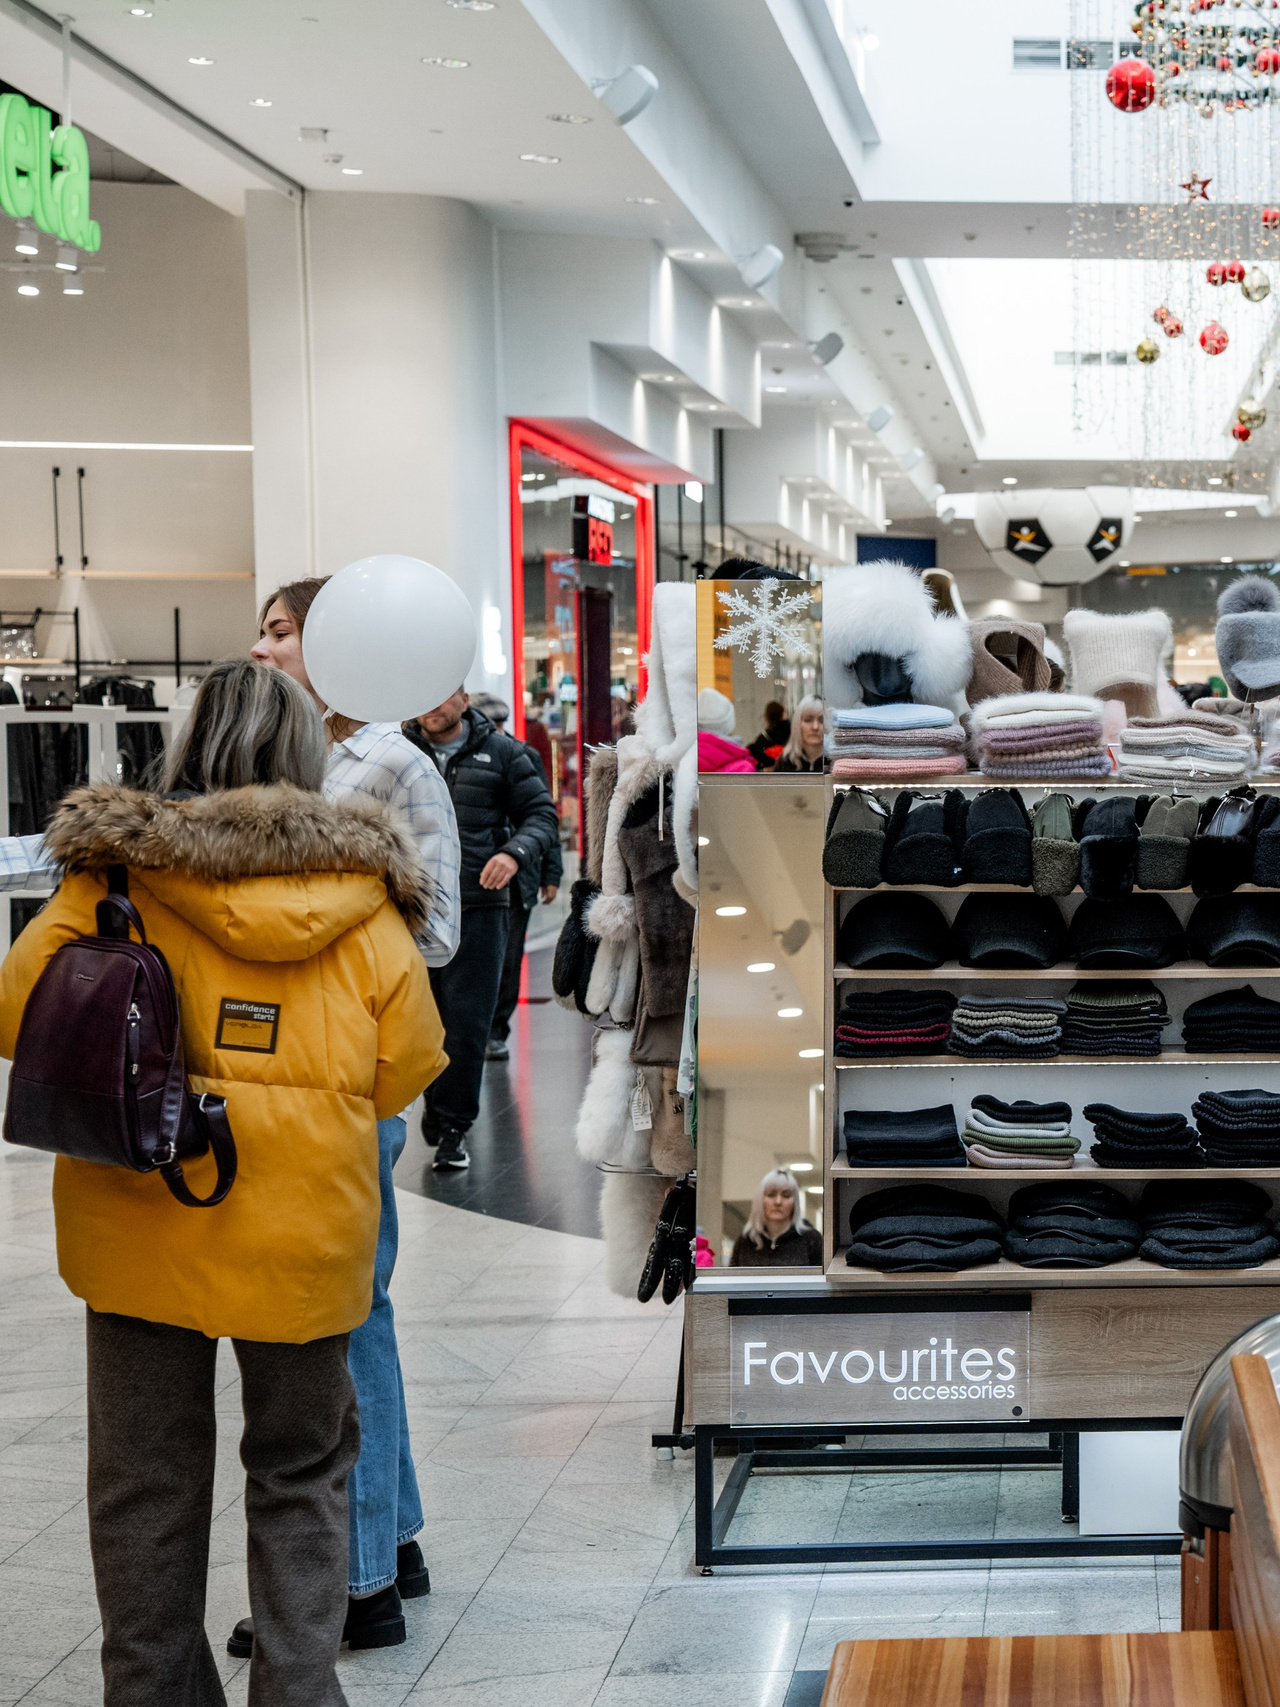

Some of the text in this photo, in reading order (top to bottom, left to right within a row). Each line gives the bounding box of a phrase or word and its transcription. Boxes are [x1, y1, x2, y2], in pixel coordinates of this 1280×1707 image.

[225, 1003, 276, 1014] confidence
[253, 1013, 275, 1021] starts
[744, 1337, 1016, 1385] Favourites
[893, 1381, 1015, 1400] accessories
